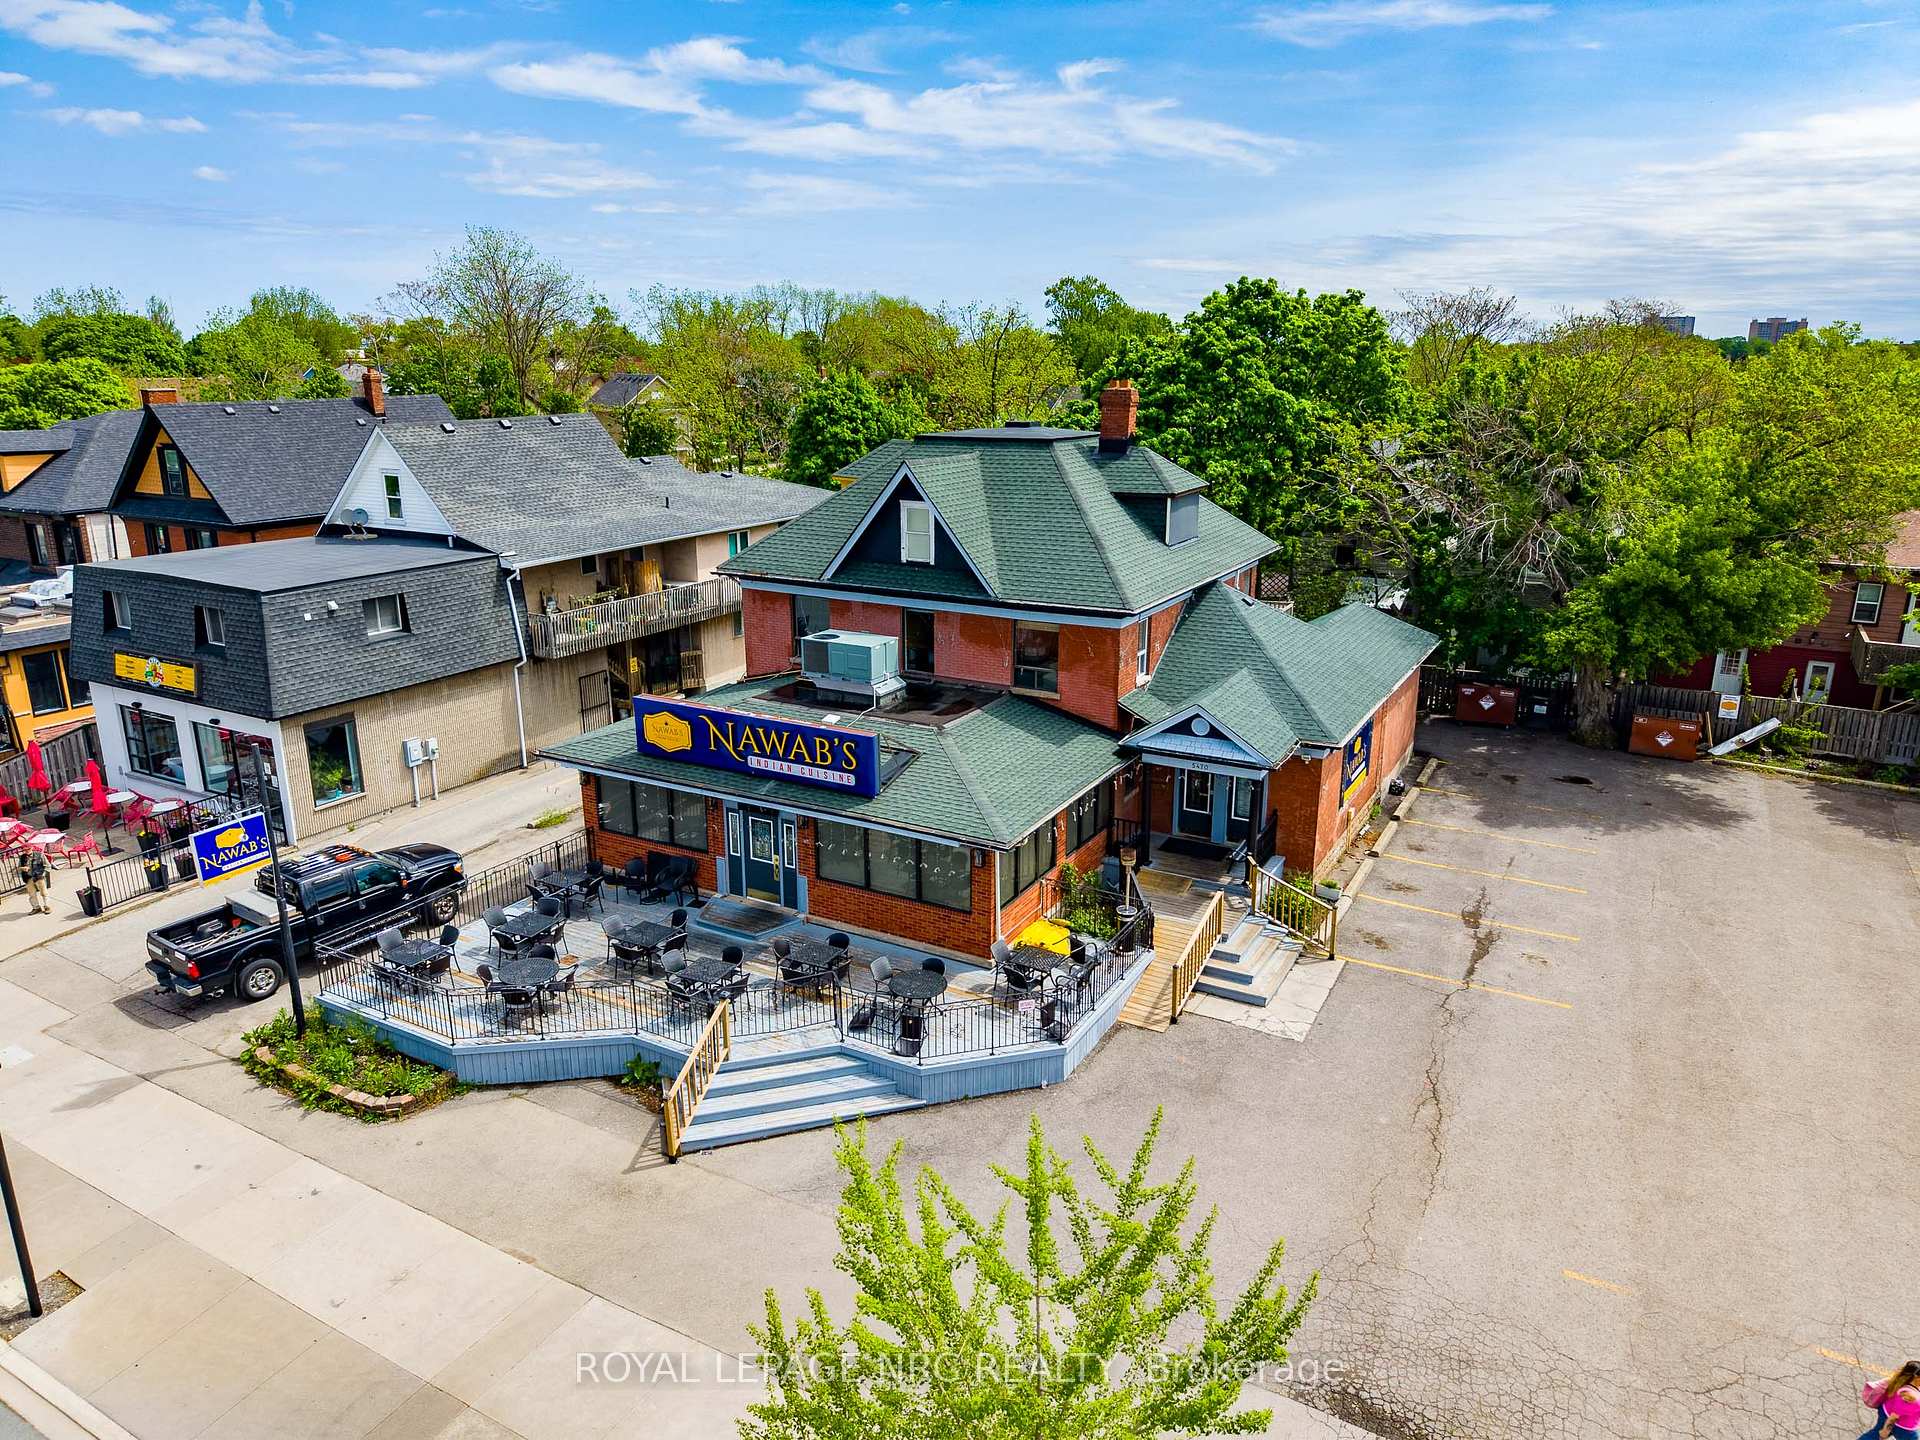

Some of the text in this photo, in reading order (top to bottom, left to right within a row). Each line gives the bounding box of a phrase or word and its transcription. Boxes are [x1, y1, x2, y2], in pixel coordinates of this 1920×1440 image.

[698, 715, 857, 770] NAWAB'S
[750, 757, 852, 784] INDIAN CUISINE
[199, 835, 268, 870] NAWAB'S
